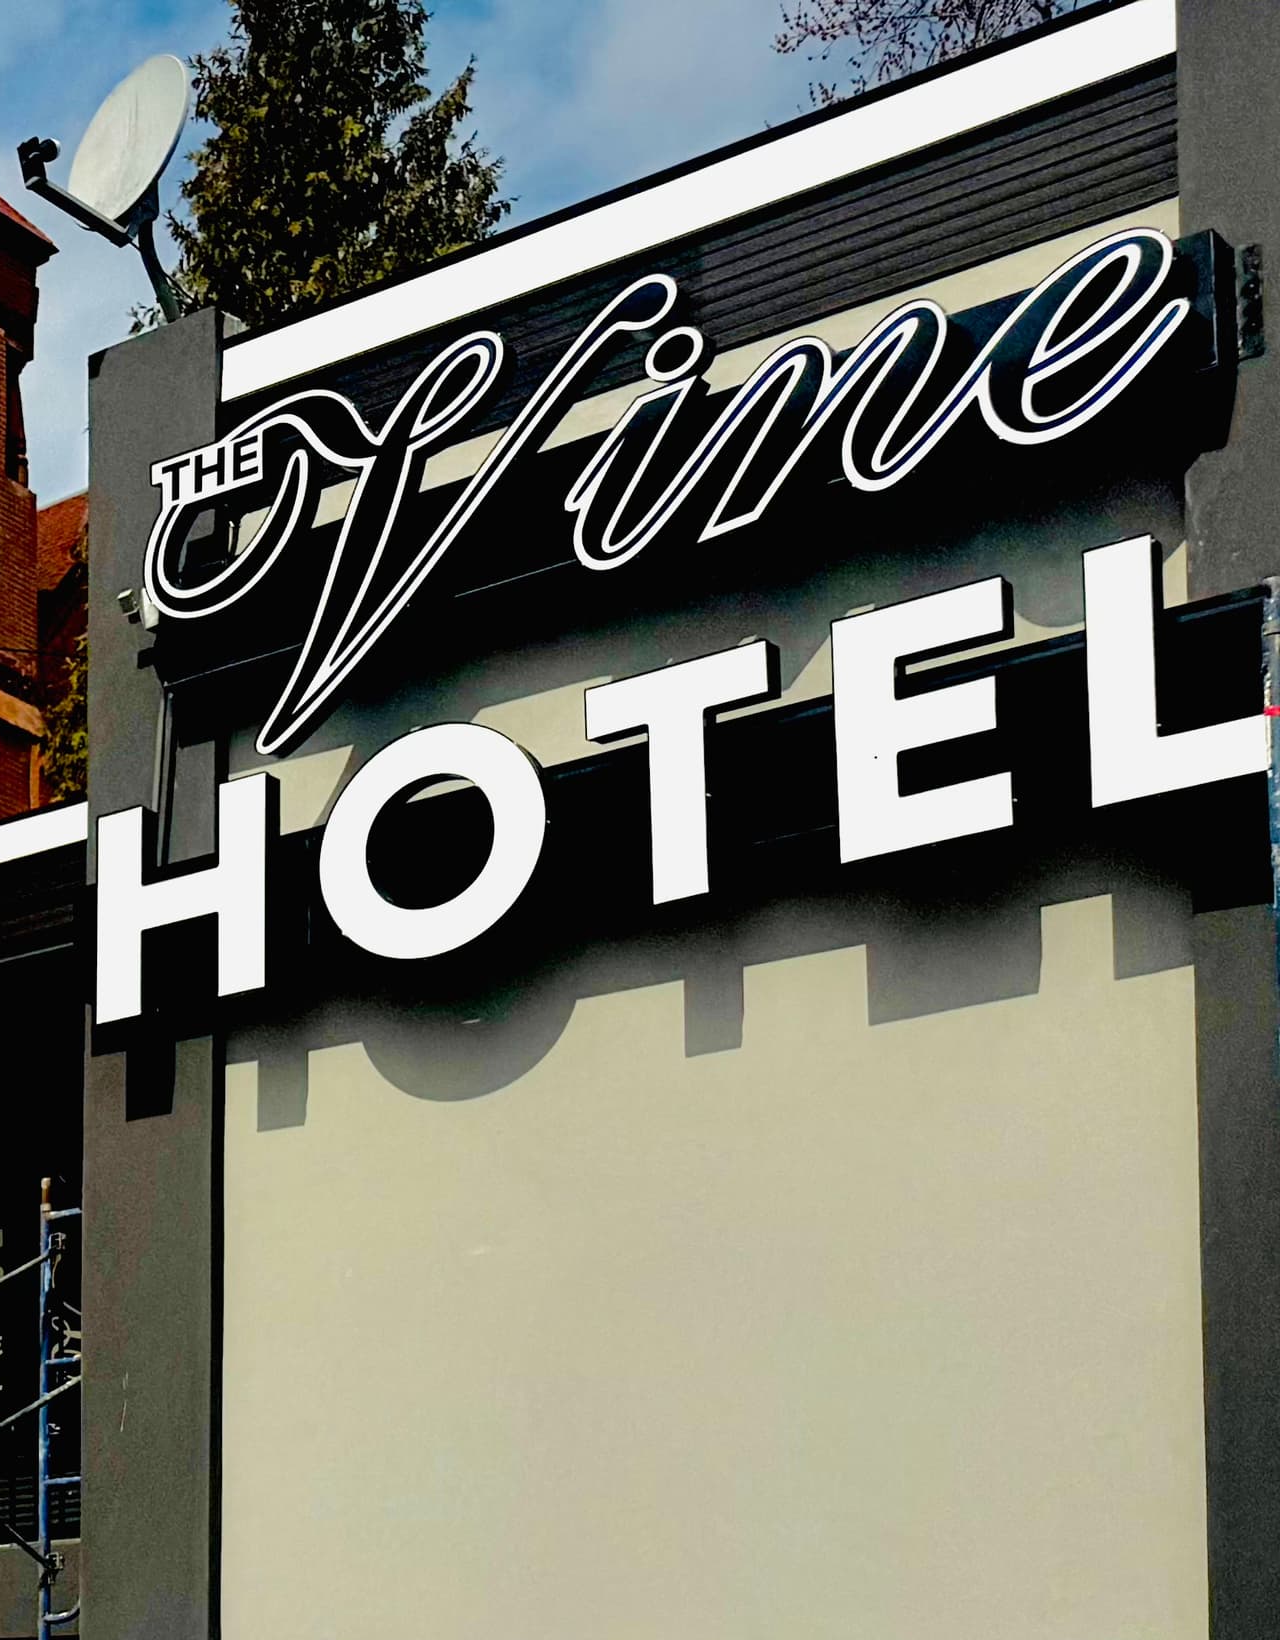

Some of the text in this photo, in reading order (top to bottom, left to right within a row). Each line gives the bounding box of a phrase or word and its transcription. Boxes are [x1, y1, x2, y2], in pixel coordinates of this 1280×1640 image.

[143, 226, 1192, 756] THE Vine
[95, 533, 1269, 1025] HOTEL
